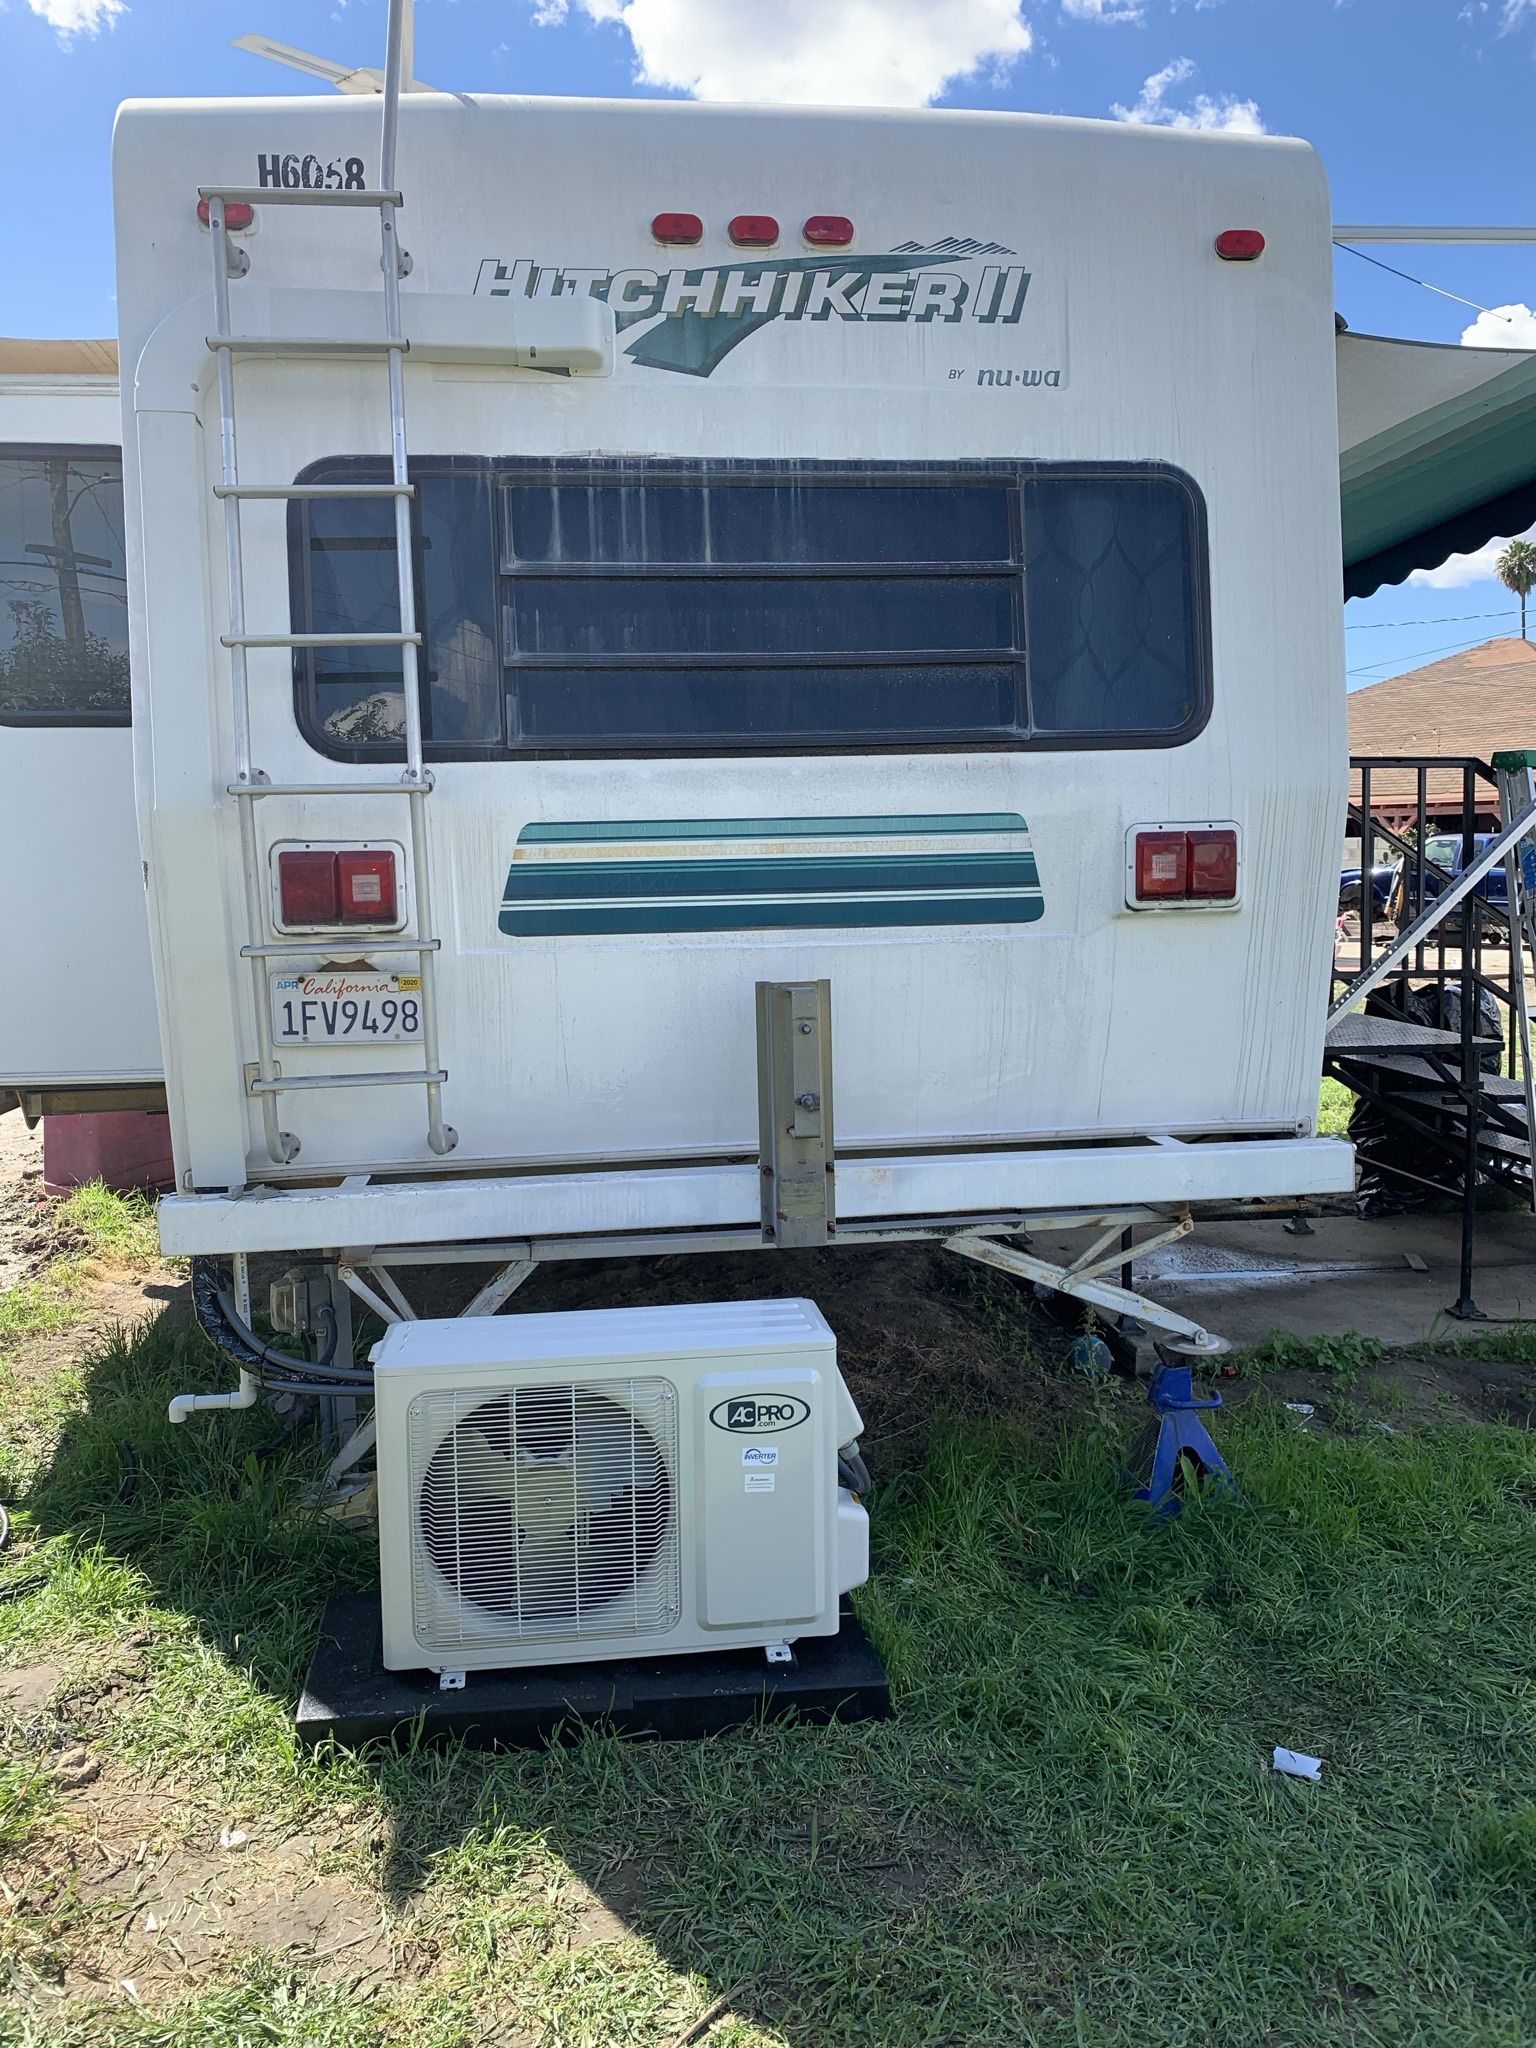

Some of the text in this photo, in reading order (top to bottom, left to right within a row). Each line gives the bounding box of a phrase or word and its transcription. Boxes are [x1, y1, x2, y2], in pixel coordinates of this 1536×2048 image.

[948, 369, 965, 380] BY
[275, 981, 299, 990] APR
[303, 978, 399, 999] California
[282, 1000, 419, 1036] 1FV9498
